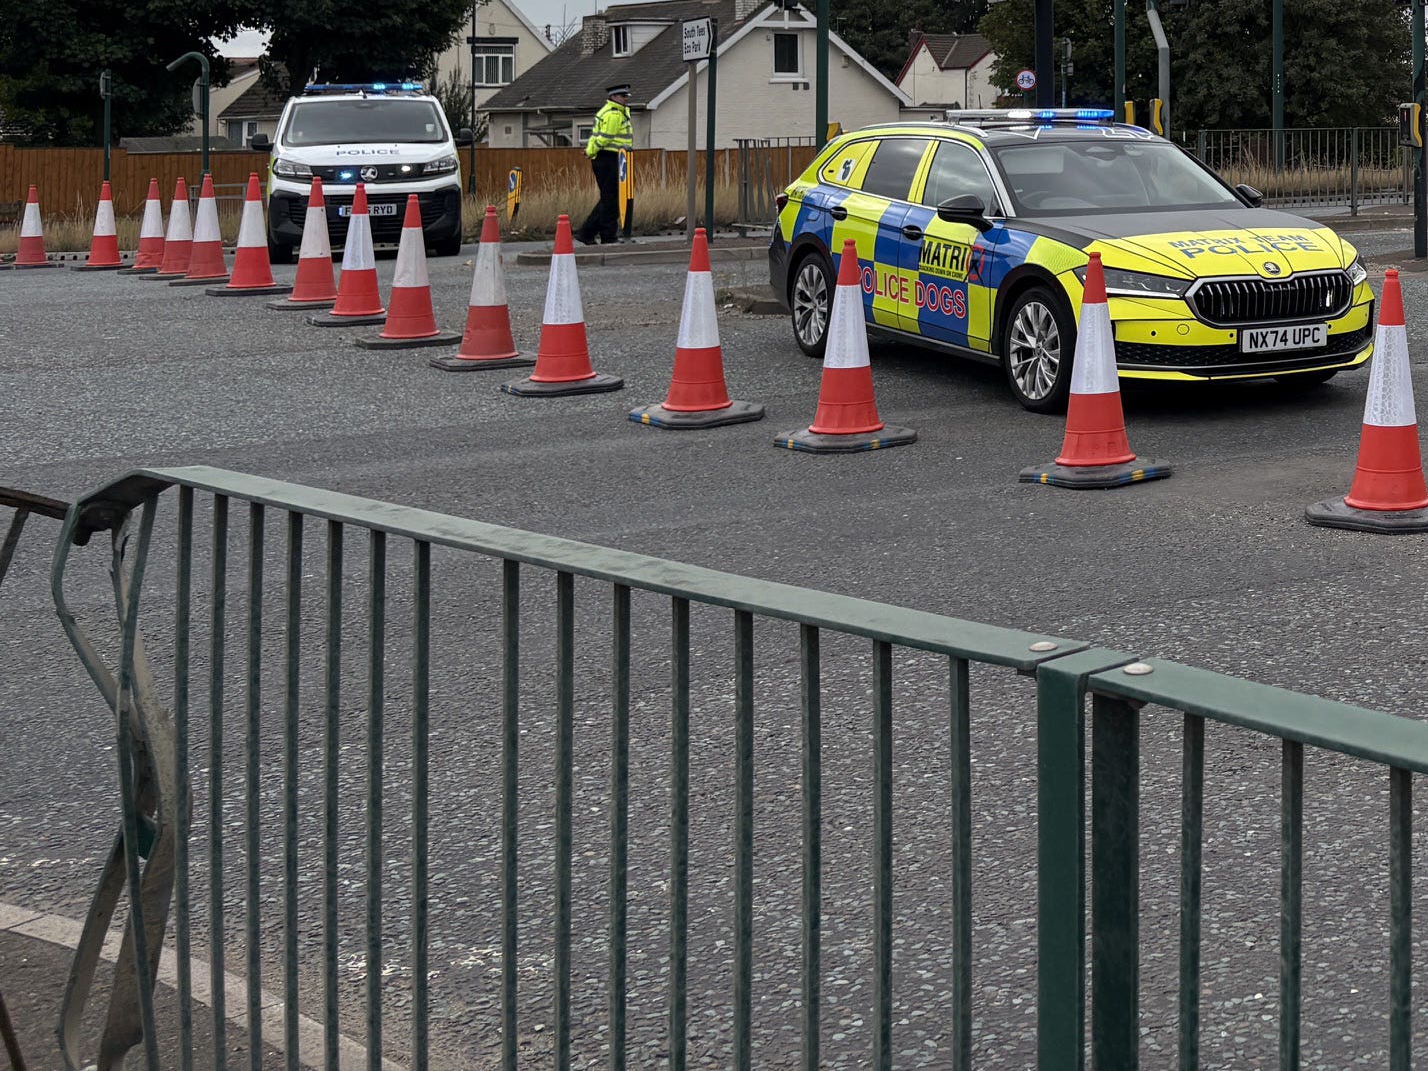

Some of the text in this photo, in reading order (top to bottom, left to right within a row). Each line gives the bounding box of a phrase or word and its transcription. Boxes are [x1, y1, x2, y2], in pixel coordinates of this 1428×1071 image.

[373, 205, 393, 215] RYD
[1168, 234, 1309, 248] MATRIX TEAM
[1179, 241, 1325, 259] POLICE
[858, 266, 966, 319] OLICE DOGS
[1249, 327, 1321, 349] NX74 UPC
